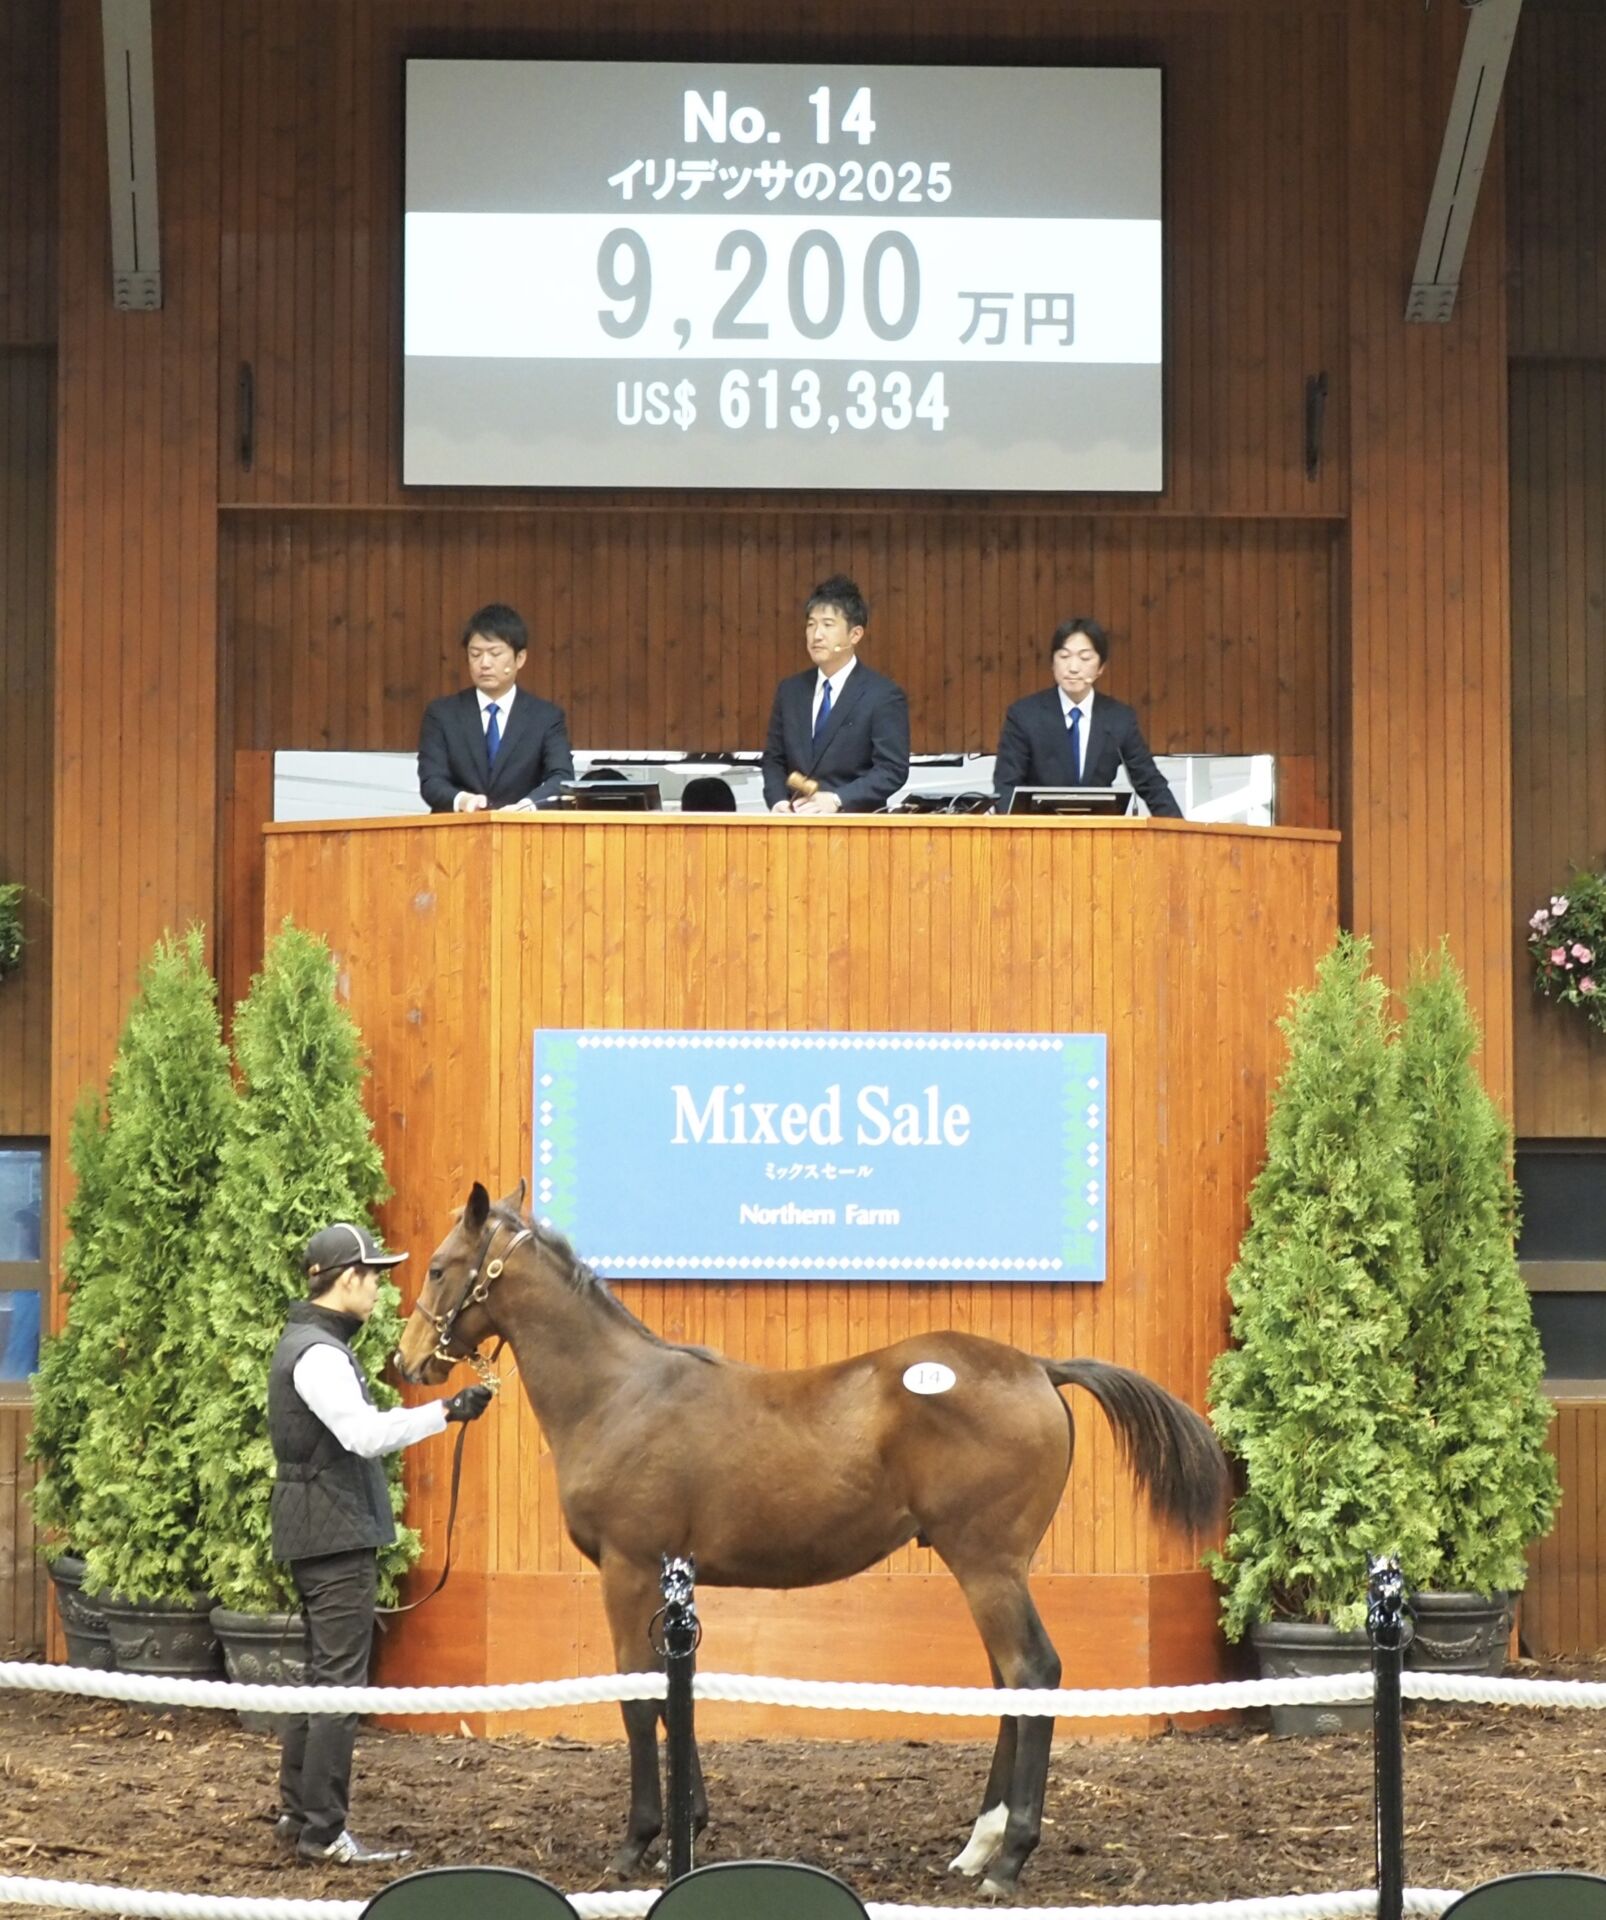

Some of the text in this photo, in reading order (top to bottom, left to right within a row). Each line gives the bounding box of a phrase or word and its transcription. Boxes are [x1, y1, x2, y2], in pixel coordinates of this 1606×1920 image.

[684, 86, 876, 145] No. 14
[607, 158, 952, 203] イリデッサの2025
[596, 227, 1075, 351] 9,200 万円
[616, 368, 950, 434] US$ 613,334
[670, 1082, 972, 1148] Mixed Sale
[764, 1161, 875, 1181] ミックスセール
[739, 1200, 902, 1227] Northern Farm
[919, 1369, 940, 1385] 14
